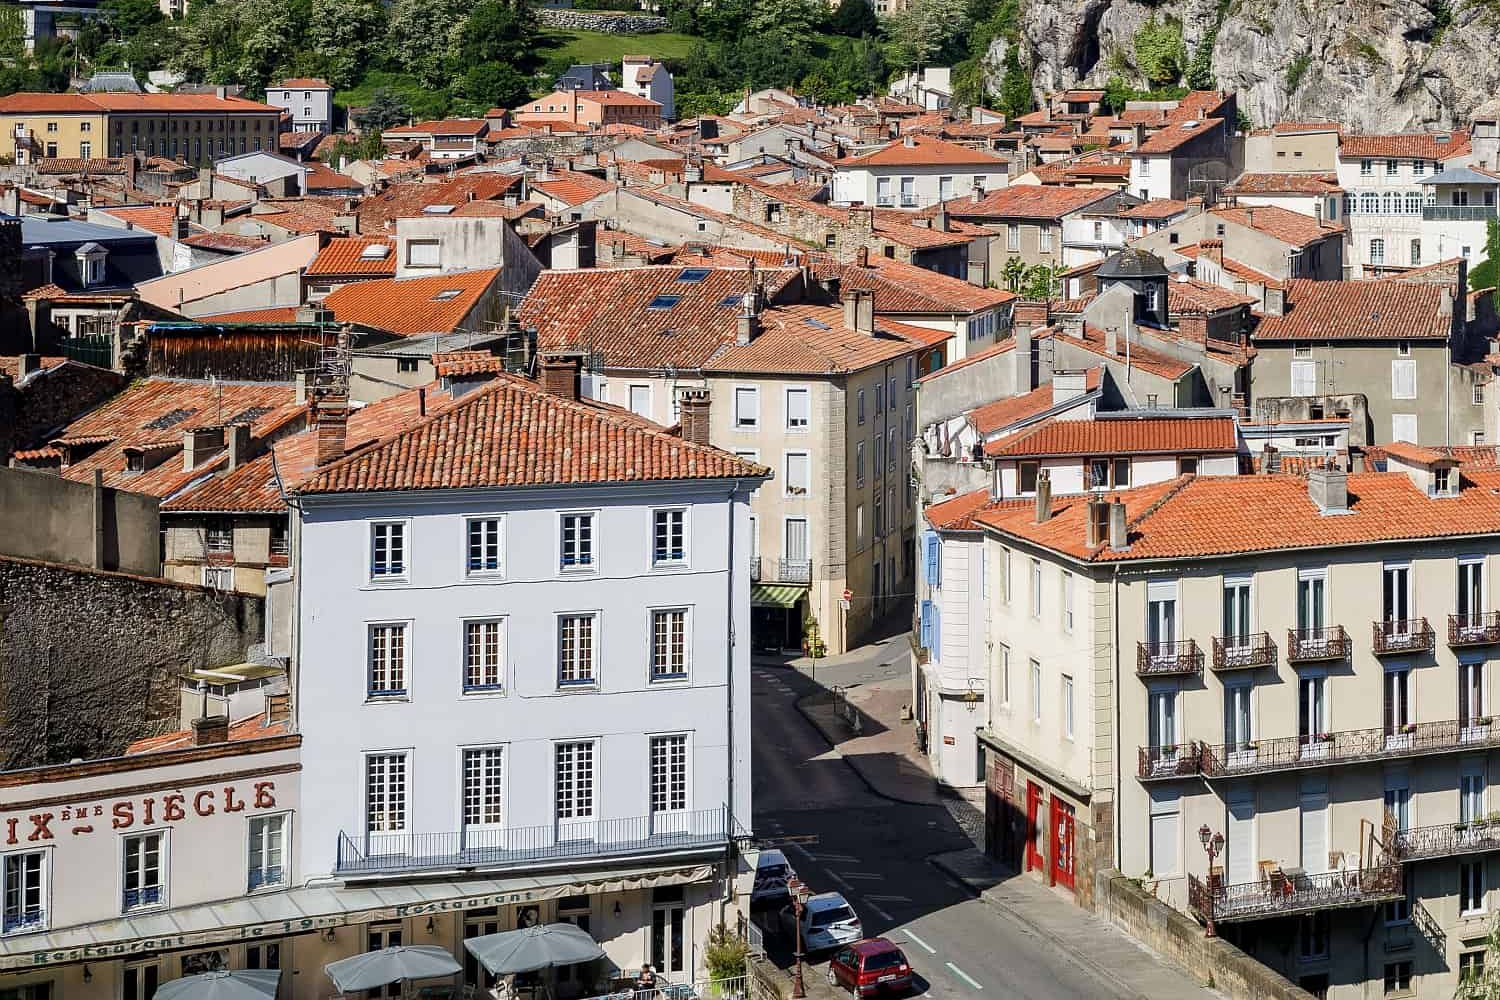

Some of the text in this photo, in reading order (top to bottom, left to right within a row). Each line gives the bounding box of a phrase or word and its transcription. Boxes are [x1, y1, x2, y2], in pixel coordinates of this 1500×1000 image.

[112, 781, 276, 829] SIÈCLE
[395, 891, 536, 917] Restaurant
[32, 935, 186, 964] Restaurant
